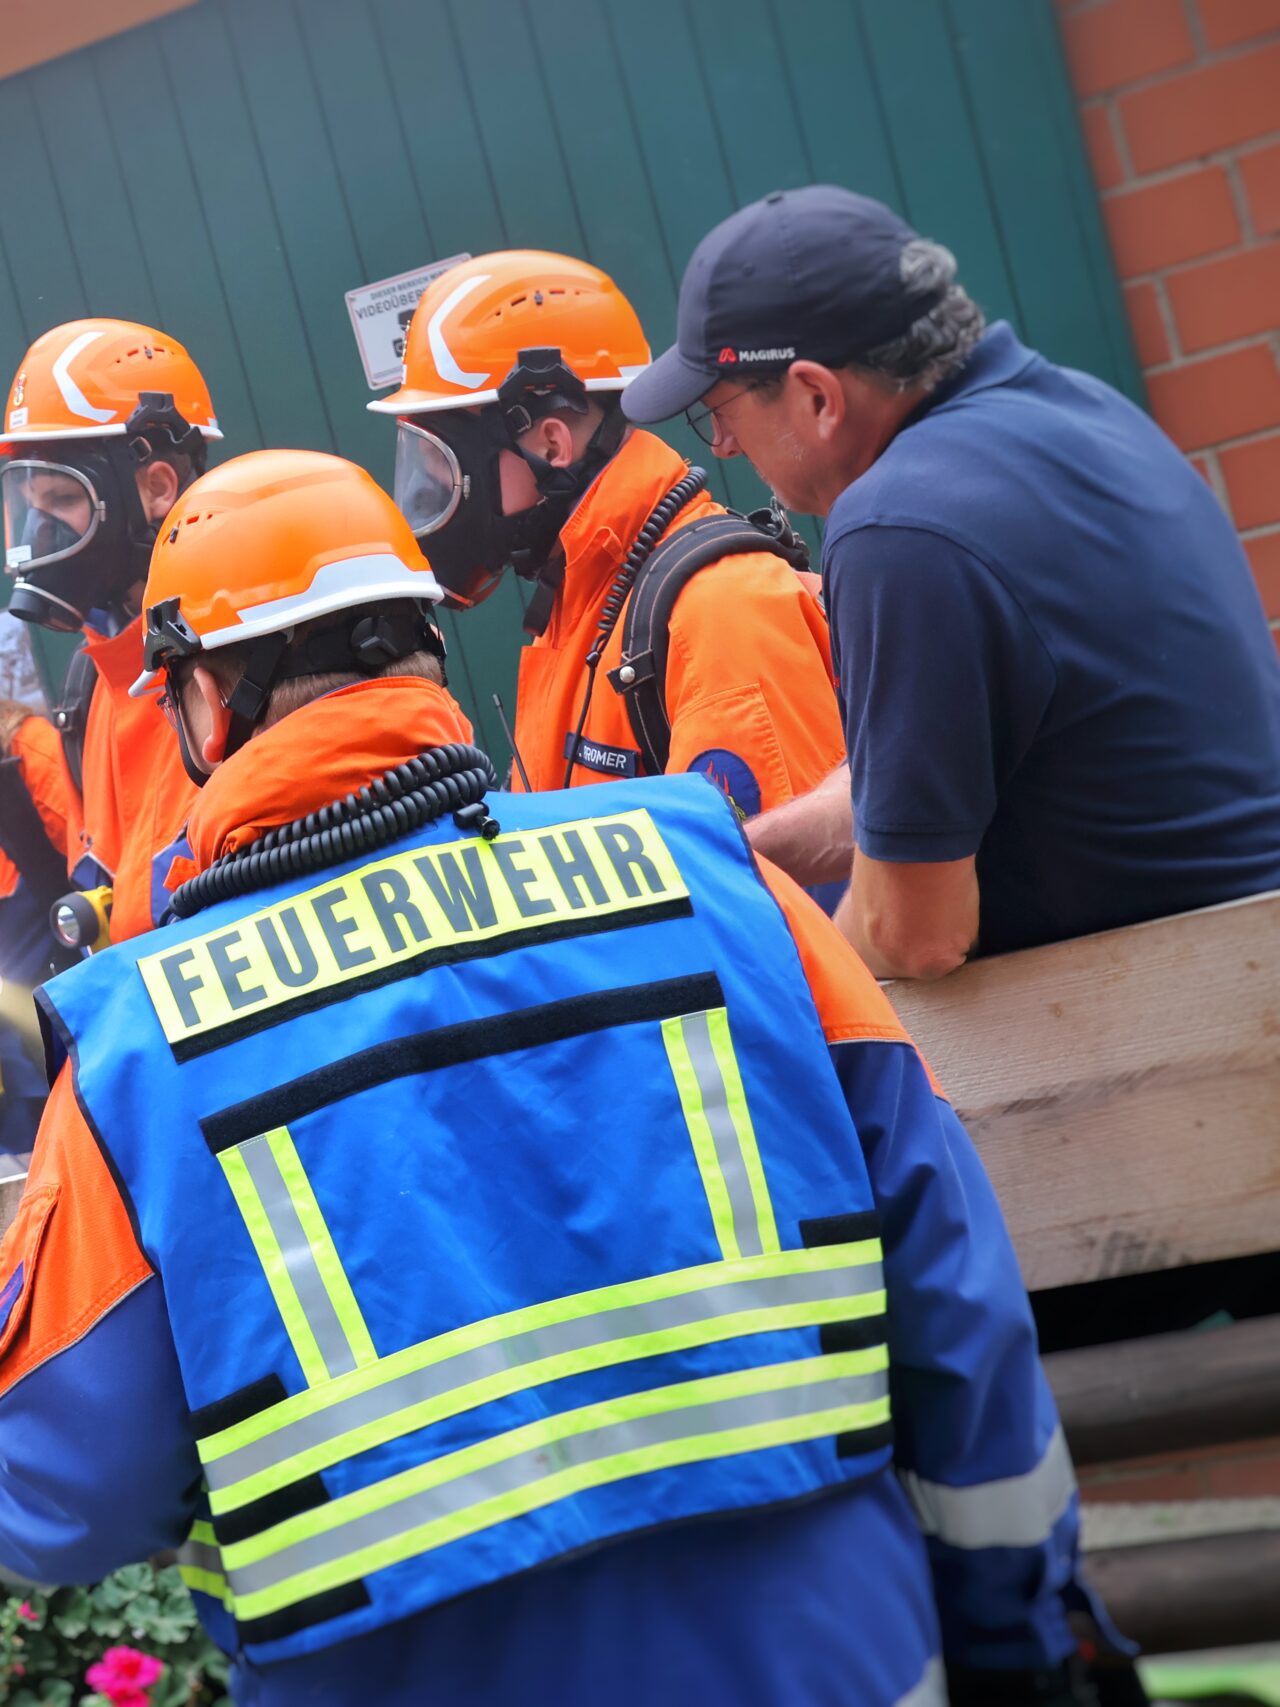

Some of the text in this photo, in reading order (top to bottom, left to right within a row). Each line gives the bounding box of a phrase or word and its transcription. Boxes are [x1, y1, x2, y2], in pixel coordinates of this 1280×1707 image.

[370, 286, 396, 300] DIESER
[396, 276, 429, 291] BEREICH
[738, 347, 796, 362] MAGIRUS
[160, 823, 665, 1028] FEUERWEHR
